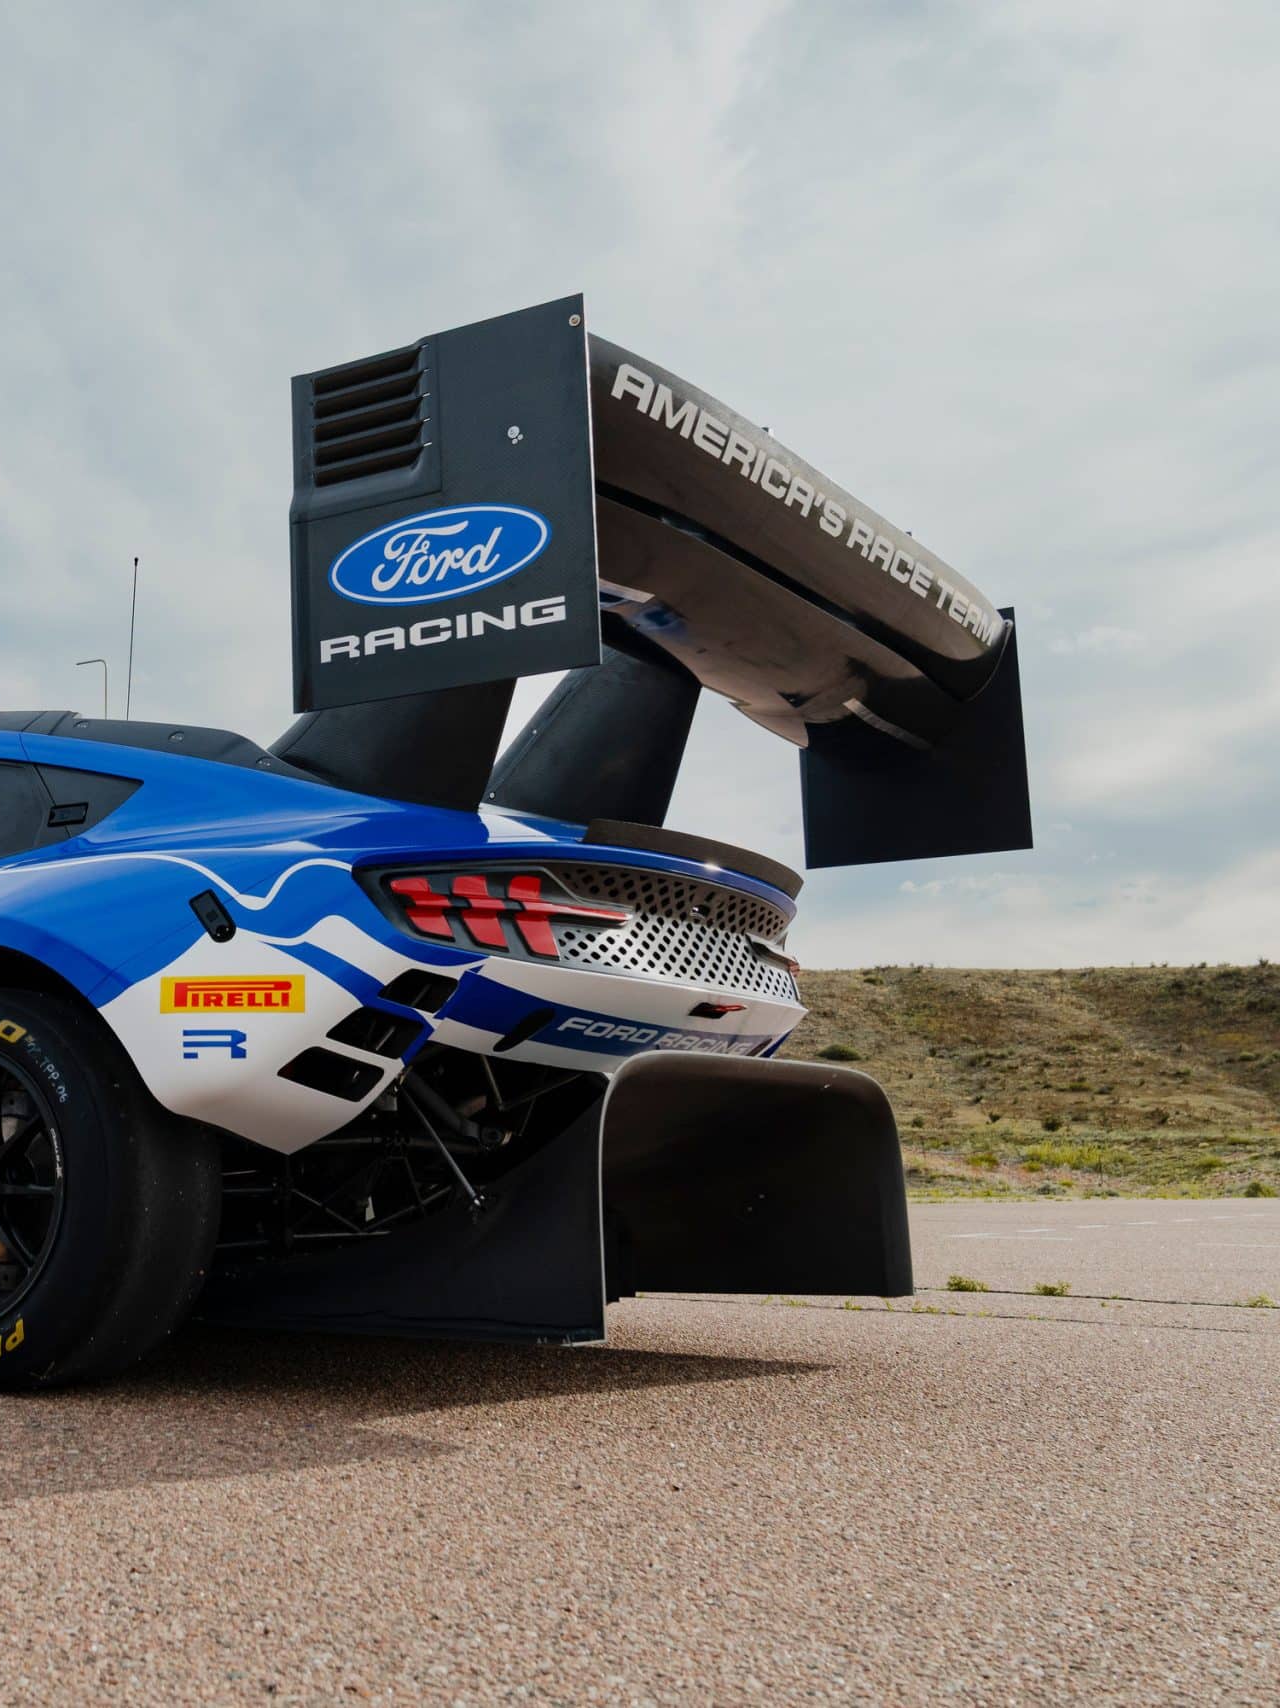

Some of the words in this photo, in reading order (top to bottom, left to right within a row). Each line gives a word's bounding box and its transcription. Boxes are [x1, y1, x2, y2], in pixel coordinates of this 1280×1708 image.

[611, 363, 846, 538] AMERICA'S
[846, 518, 934, 599] RACE
[935, 578, 995, 647] TEAM
[371, 520, 503, 592] Ford
[320, 595, 566, 663] RACING
[174, 981, 292, 1007] PIRELLI
[557, 1017, 658, 1044] FORD
[654, 1031, 755, 1056] RACING
